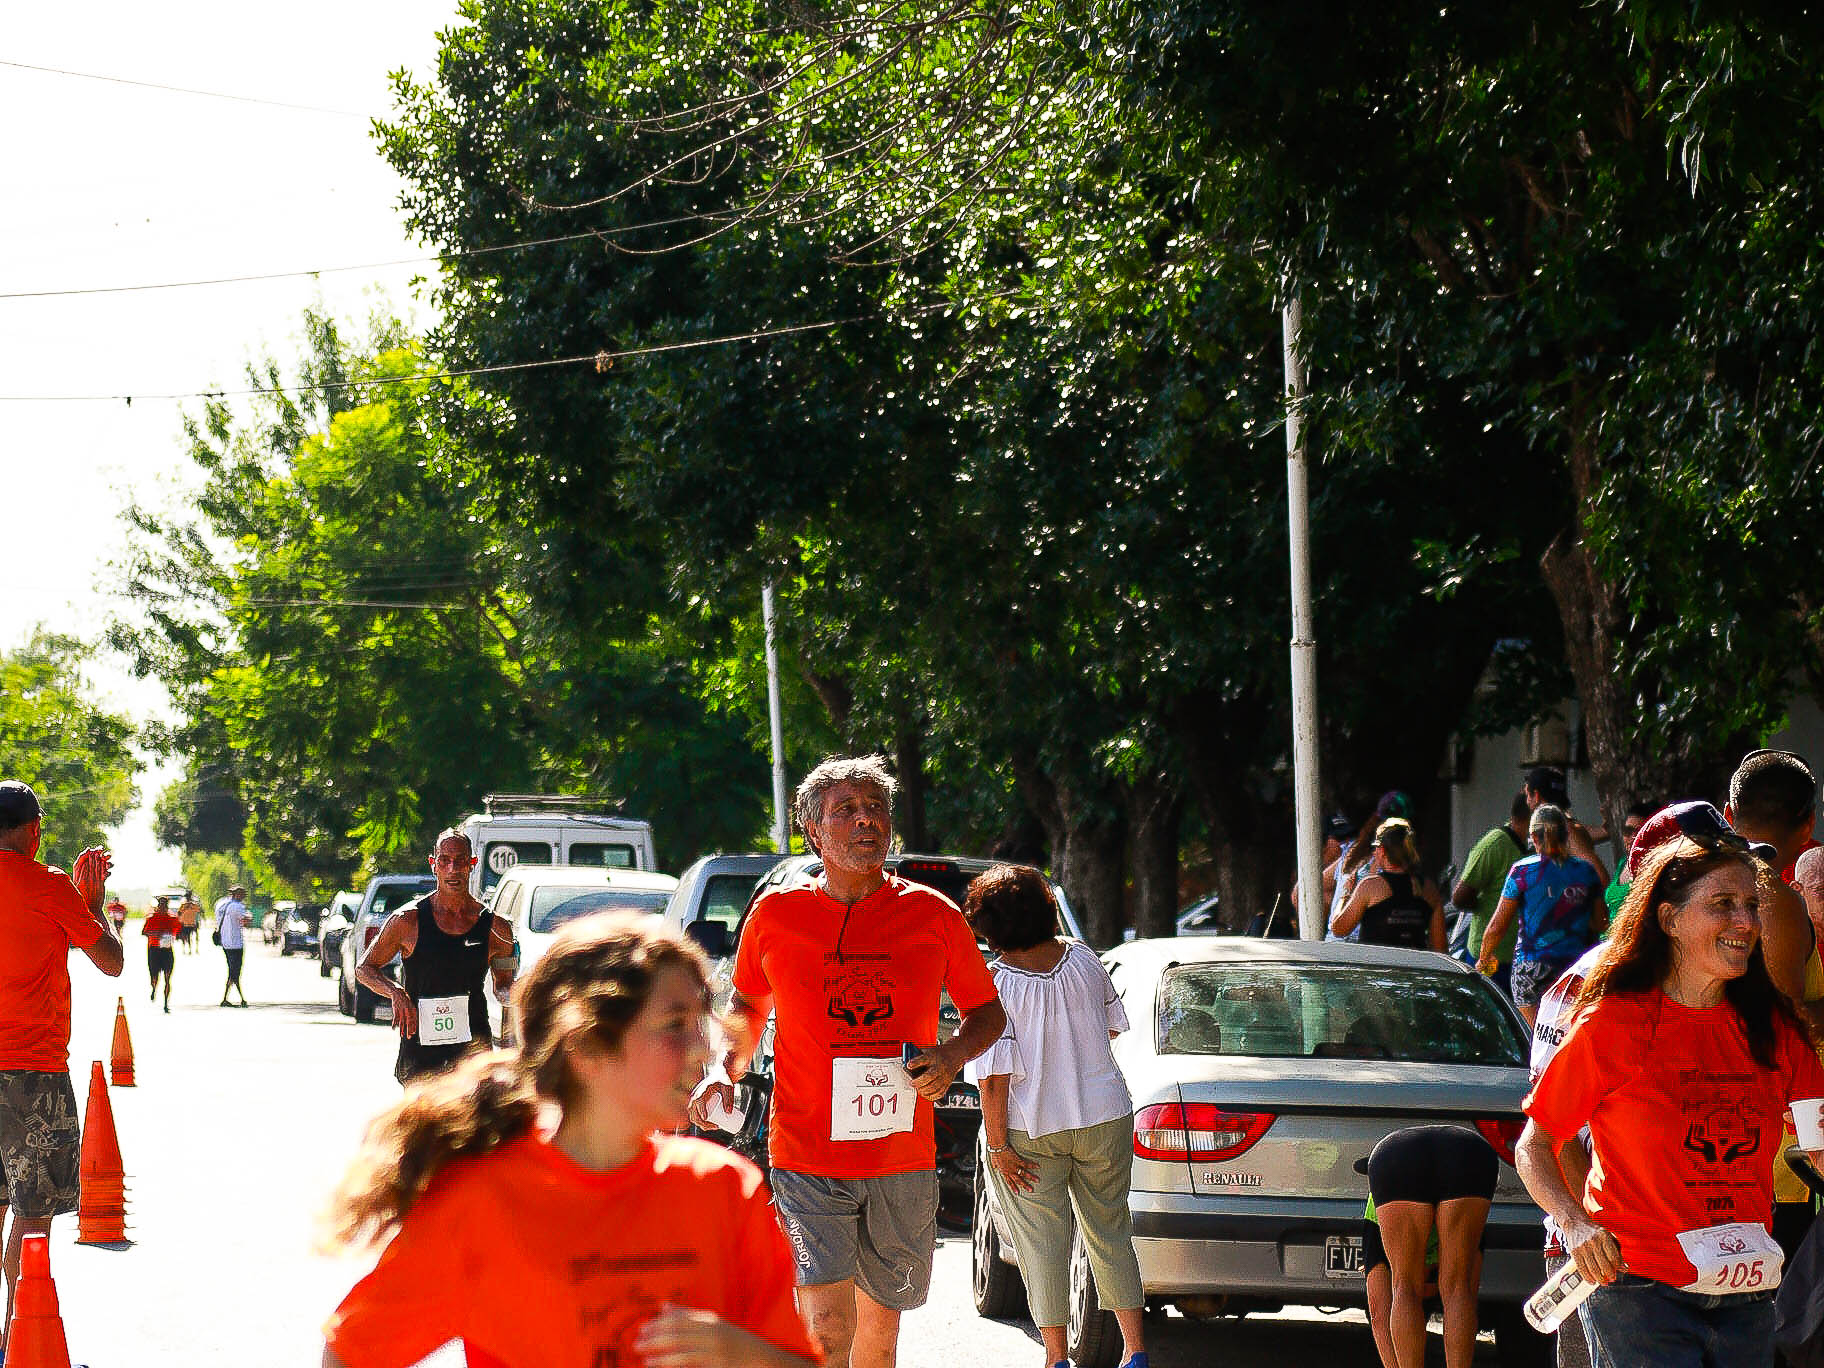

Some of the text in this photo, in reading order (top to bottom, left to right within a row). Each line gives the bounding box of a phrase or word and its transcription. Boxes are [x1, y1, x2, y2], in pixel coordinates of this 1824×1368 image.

[493, 852, 516, 869] 110
[434, 1017, 454, 1032] 50
[852, 1093, 898, 1117] 101
[1203, 1172, 1263, 1187] RENAULT
[789, 1219, 811, 1269] JORDAN
[1715, 1260, 1764, 1288] 105
